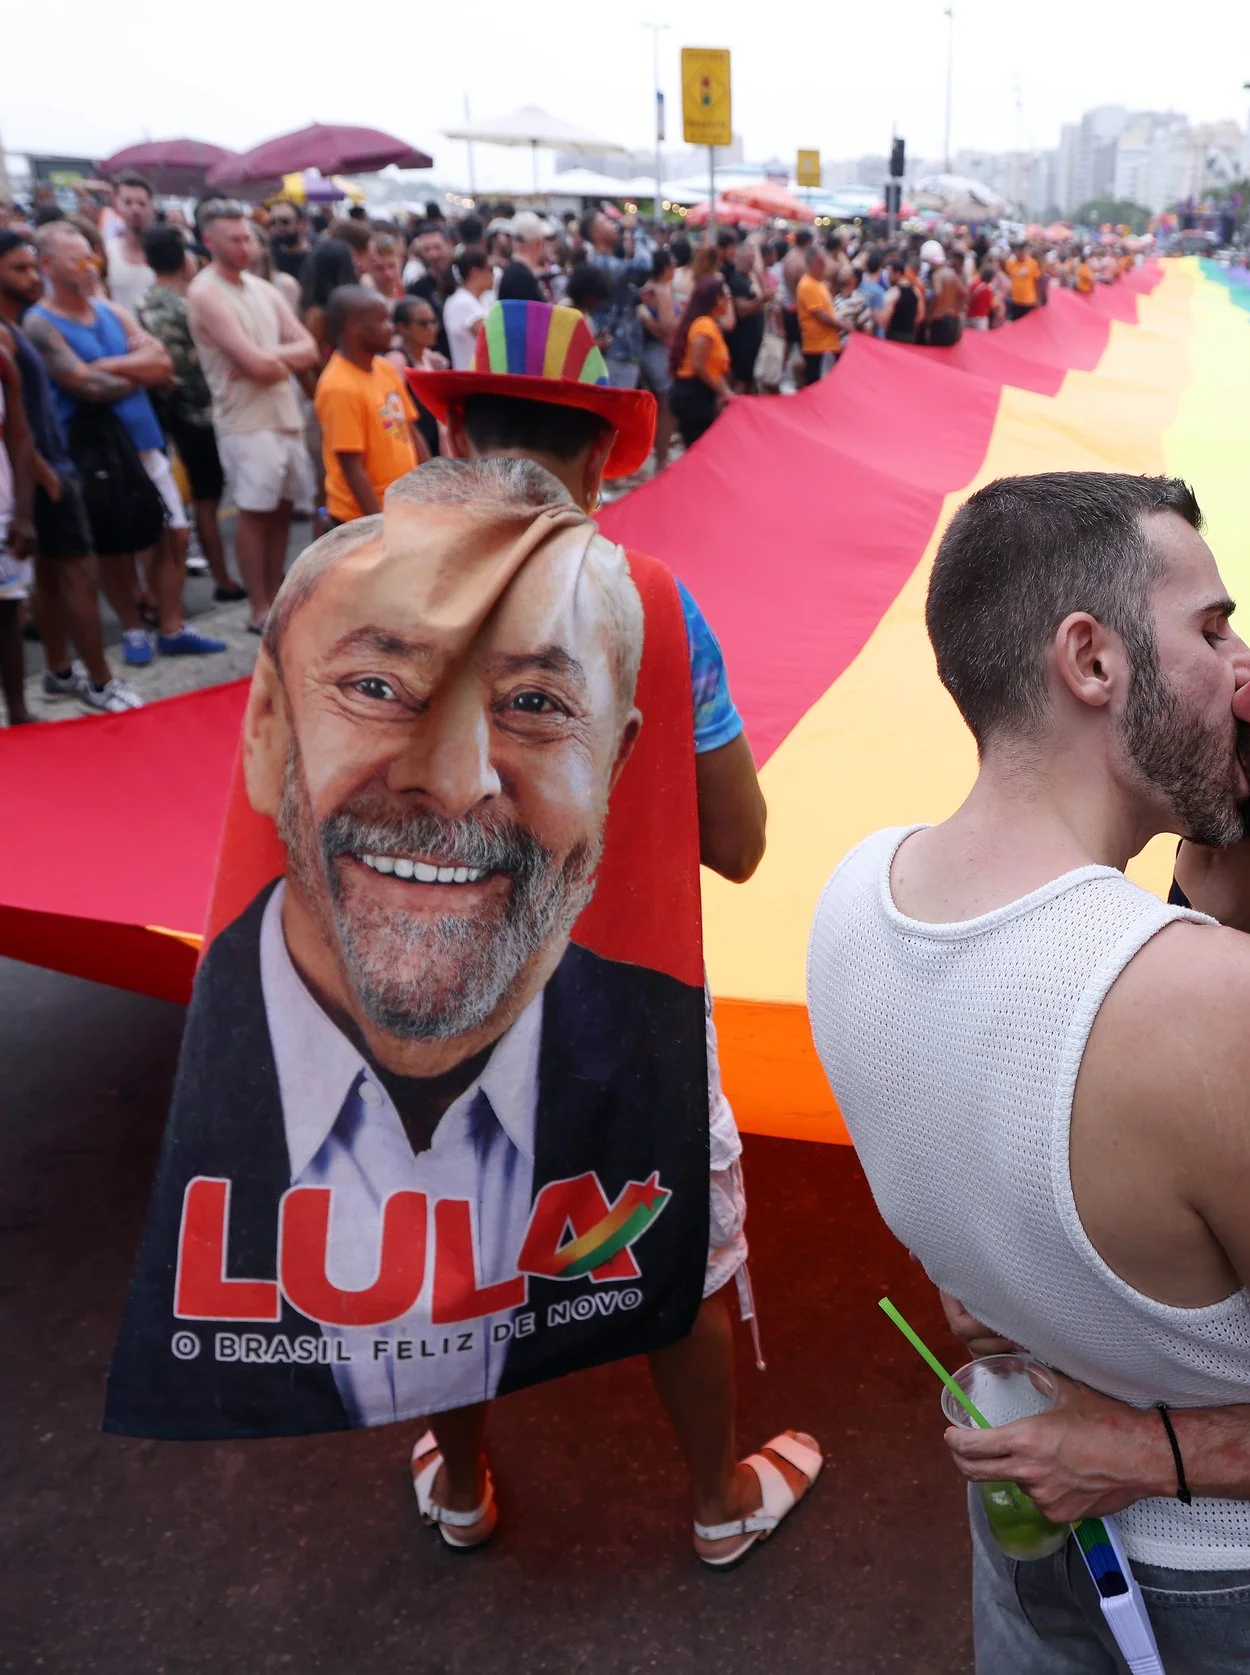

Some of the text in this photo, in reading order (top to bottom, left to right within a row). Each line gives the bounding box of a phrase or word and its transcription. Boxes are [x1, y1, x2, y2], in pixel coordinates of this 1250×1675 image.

[173, 1170, 672, 1327] LULA
[171, 1287, 644, 1363] O BRASIL FELIZ DE NOVO
